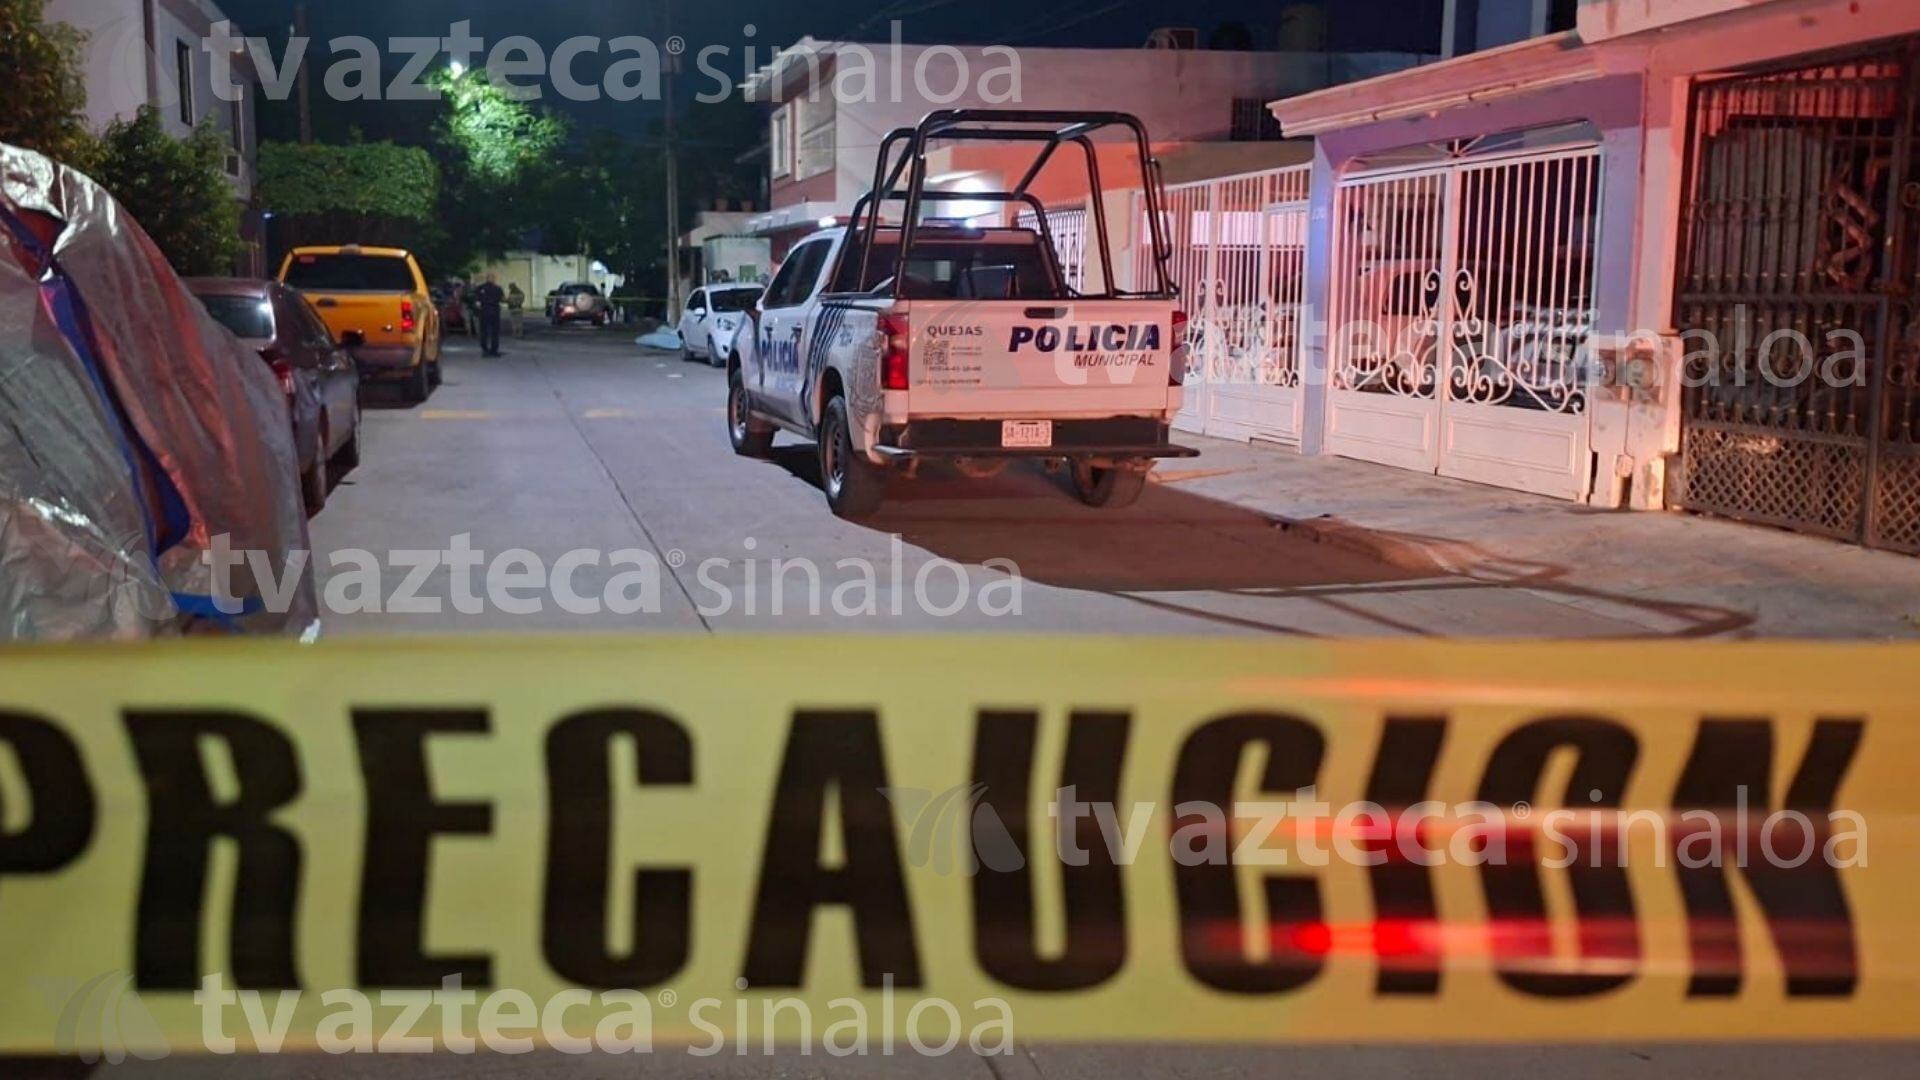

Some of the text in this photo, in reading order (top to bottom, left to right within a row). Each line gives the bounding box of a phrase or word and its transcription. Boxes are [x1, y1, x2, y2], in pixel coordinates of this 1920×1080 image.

[927, 325, 983, 336] QUEJAS
[1008, 324, 1160, 353] POLICIA
[1074, 354, 1155, 367] MUNICIPAL
